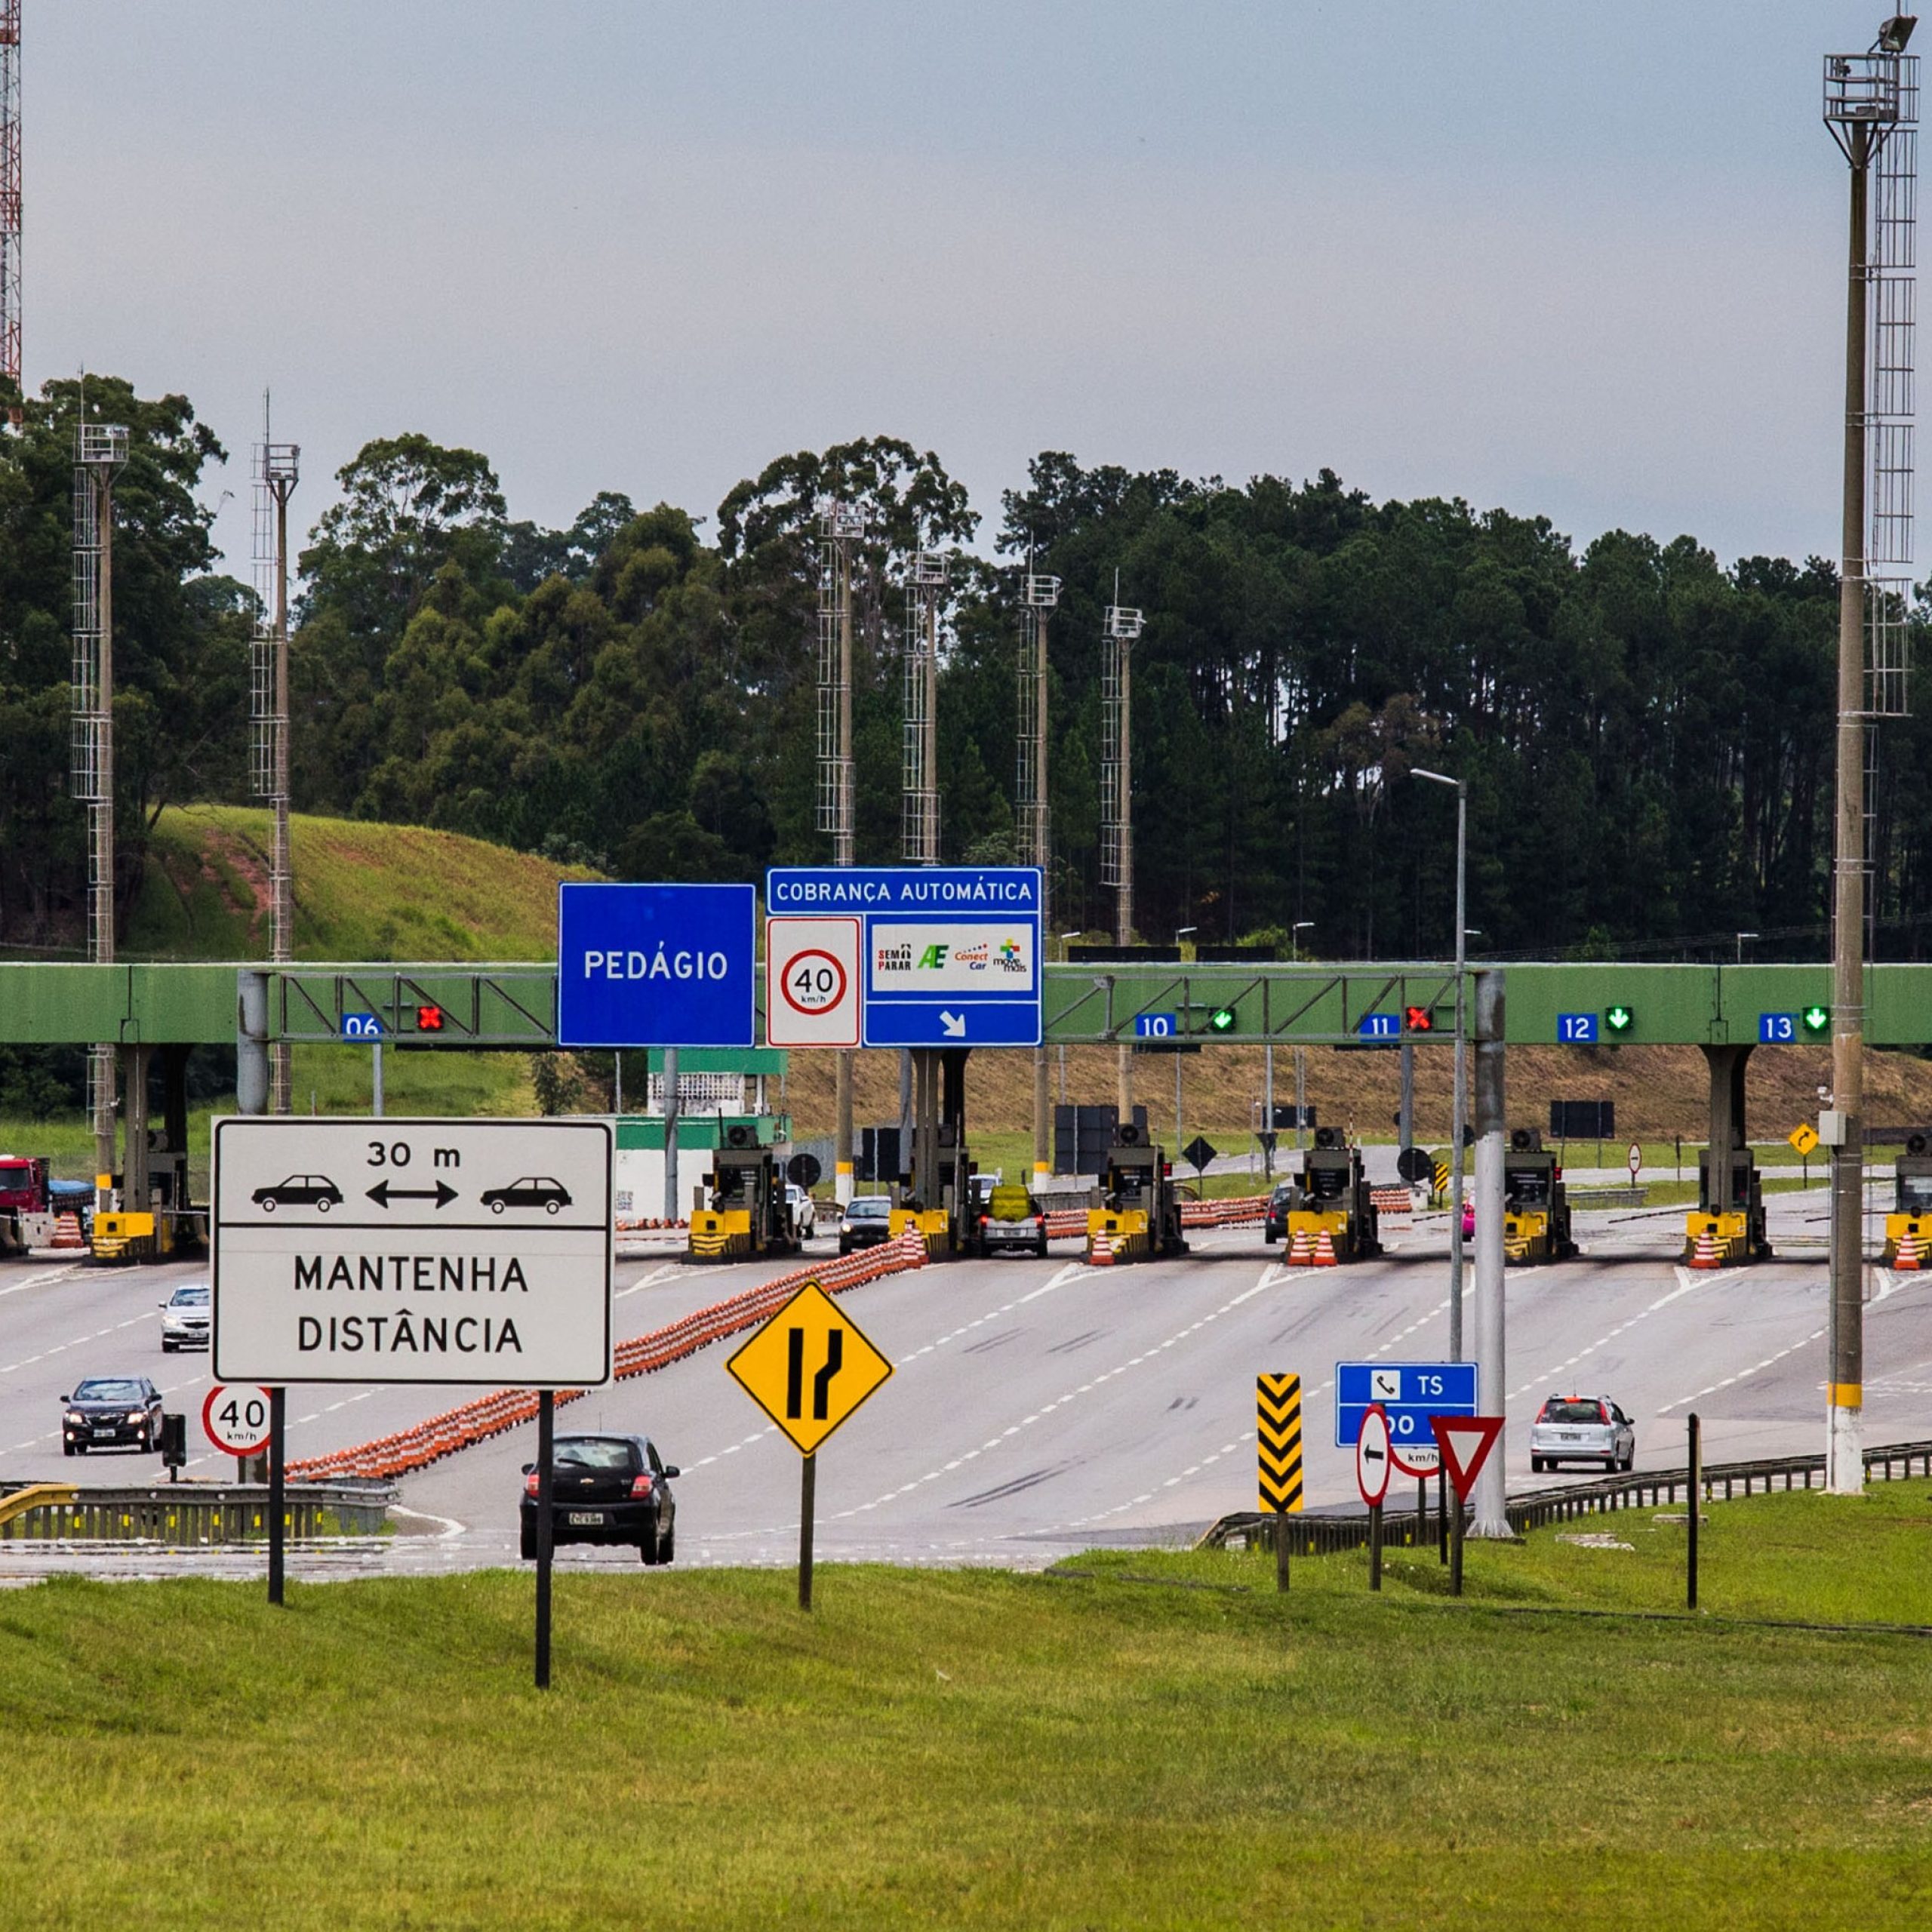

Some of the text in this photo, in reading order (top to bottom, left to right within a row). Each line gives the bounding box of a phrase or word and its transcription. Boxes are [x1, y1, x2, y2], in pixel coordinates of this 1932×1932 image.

[777, 875, 1032, 902] COBRANÇA AUTOMÁTICA
[585, 940, 728, 980] PEDÁGIO
[878, 949, 900, 959] SEM
[955, 952, 988, 961] Conect
[878, 961, 911, 971] PARAR
[969, 961, 986, 971] Car
[794, 968, 833, 993] 40
[346, 1017, 379, 1035] 06
[1143, 1017, 1168, 1037] 10
[1372, 1017, 1388, 1035] 11
[1565, 1017, 1589, 1038] 12
[1767, 1017, 1792, 1038] 13
[367, 1141, 460, 1168] 30 m
[294, 1255, 528, 1292] MANTENHA
[299, 1308, 522, 1353] DISTÂNCIA
[1417, 1376, 1443, 1395] TS
[219, 1400, 265, 1428] 40
[226, 1432, 257, 1441] km/h
[1407, 1453, 1438, 1463] km/h
